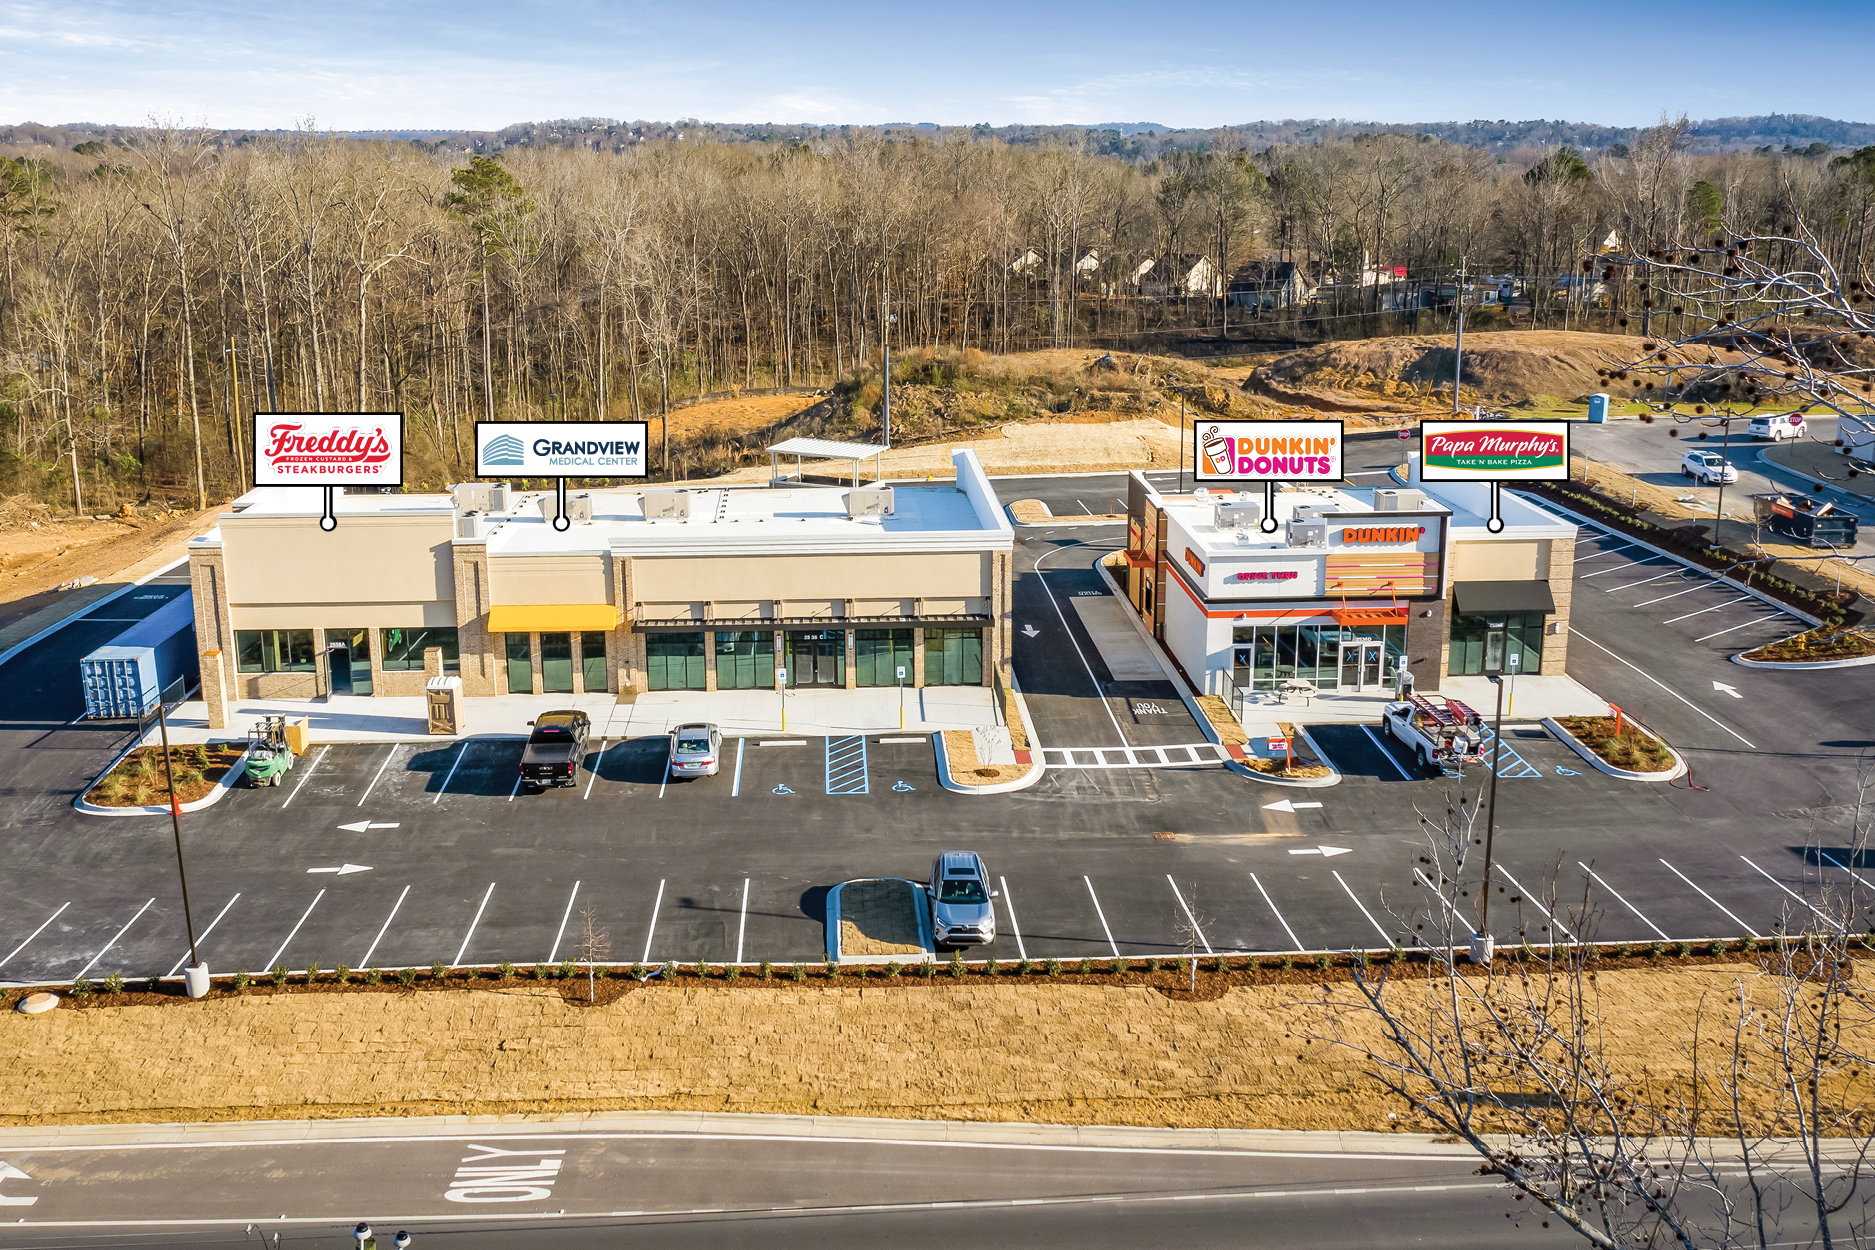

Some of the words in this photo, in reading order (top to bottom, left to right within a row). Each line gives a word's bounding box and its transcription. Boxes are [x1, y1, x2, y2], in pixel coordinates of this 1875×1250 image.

[1343, 527, 1425, 544] DUNKIN'
[1238, 572, 1268, 581] DRIVE
[1270, 571, 1298, 581] THRU
[1132, 706, 1168, 715] THANK
[444, 1143, 567, 1203] ONLY
